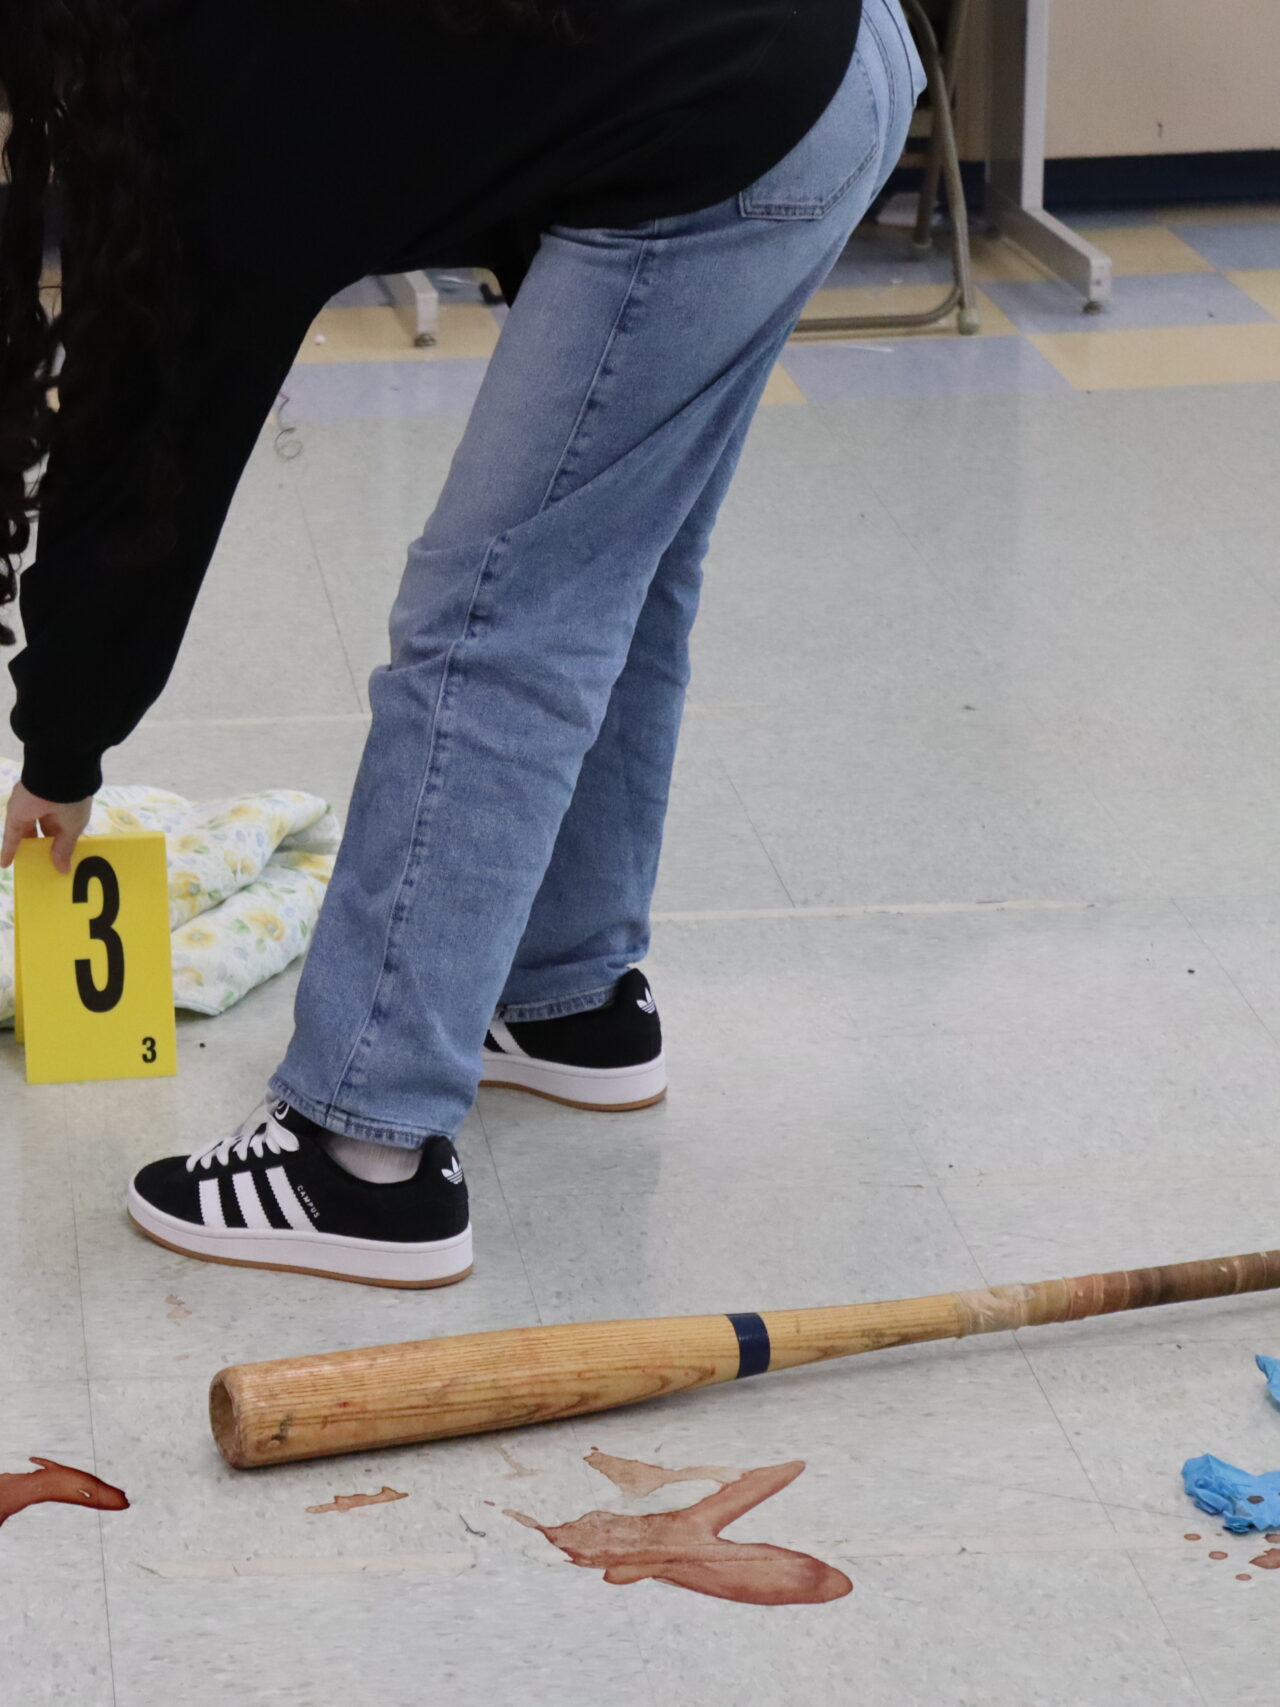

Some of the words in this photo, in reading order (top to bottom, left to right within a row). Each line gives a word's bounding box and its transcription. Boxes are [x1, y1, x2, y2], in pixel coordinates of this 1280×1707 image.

[72, 856, 125, 1013] 3
[142, 1037, 157, 1063] 3
[297, 1185, 320, 1219] CAMPUS
